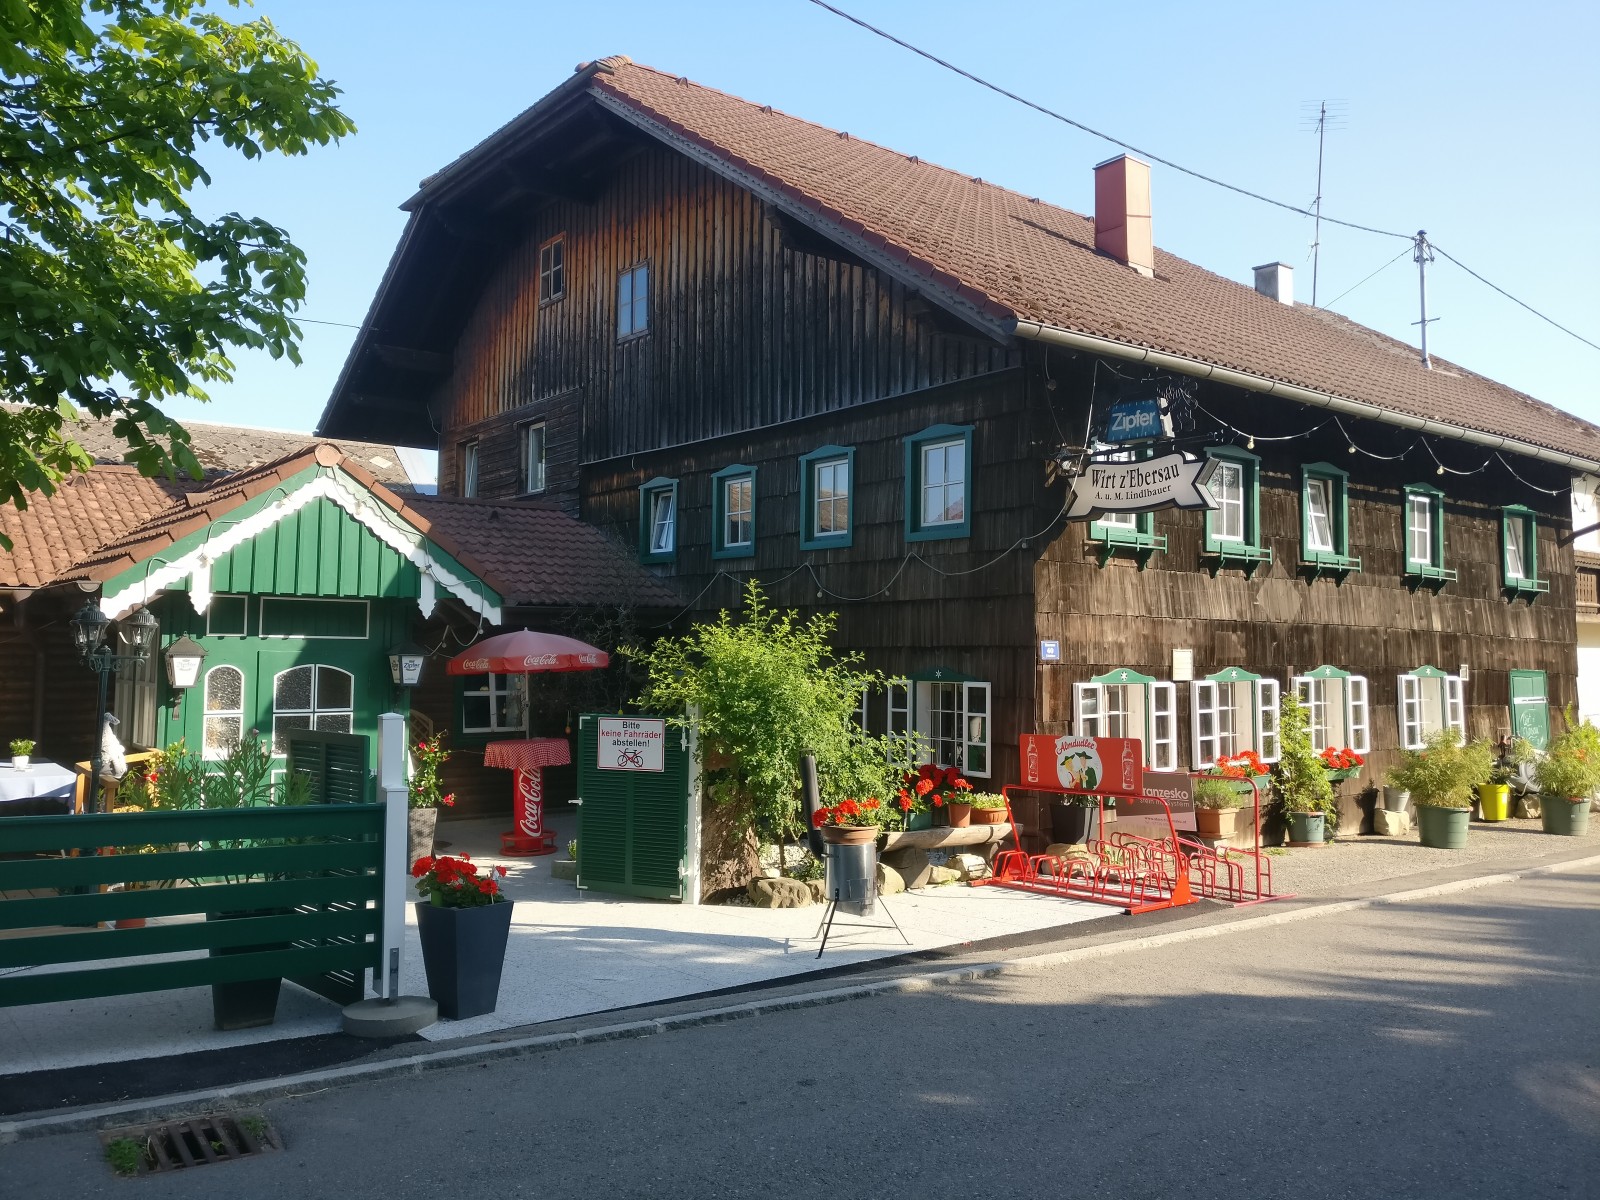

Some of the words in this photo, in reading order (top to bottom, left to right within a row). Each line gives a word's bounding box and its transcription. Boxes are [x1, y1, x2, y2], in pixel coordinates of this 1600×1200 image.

[1111, 409, 1156, 432] Zipfer
[1091, 468, 1116, 490] Wirt
[1119, 463, 1180, 489] z'Ebersau
[1095, 491, 1103, 500] A.
[1105, 493, 1112, 501] u.
[1113, 492, 1124, 501] M.
[1126, 485, 1171, 500] Lindlbauer
[462, 658, 490, 670] Coca-Cola
[523, 653, 558, 667] Coca-Cola
[622, 721, 641, 729] Bitte
[601, 729, 621, 737] keine
[623, 730, 662, 739] Fahrräder
[612, 739, 650, 748] abstellen!
[1056, 739, 1095, 755] Almdudler
[1142, 787, 1189, 800] ranzesko
[518, 767, 542, 837] Coca-Cola
